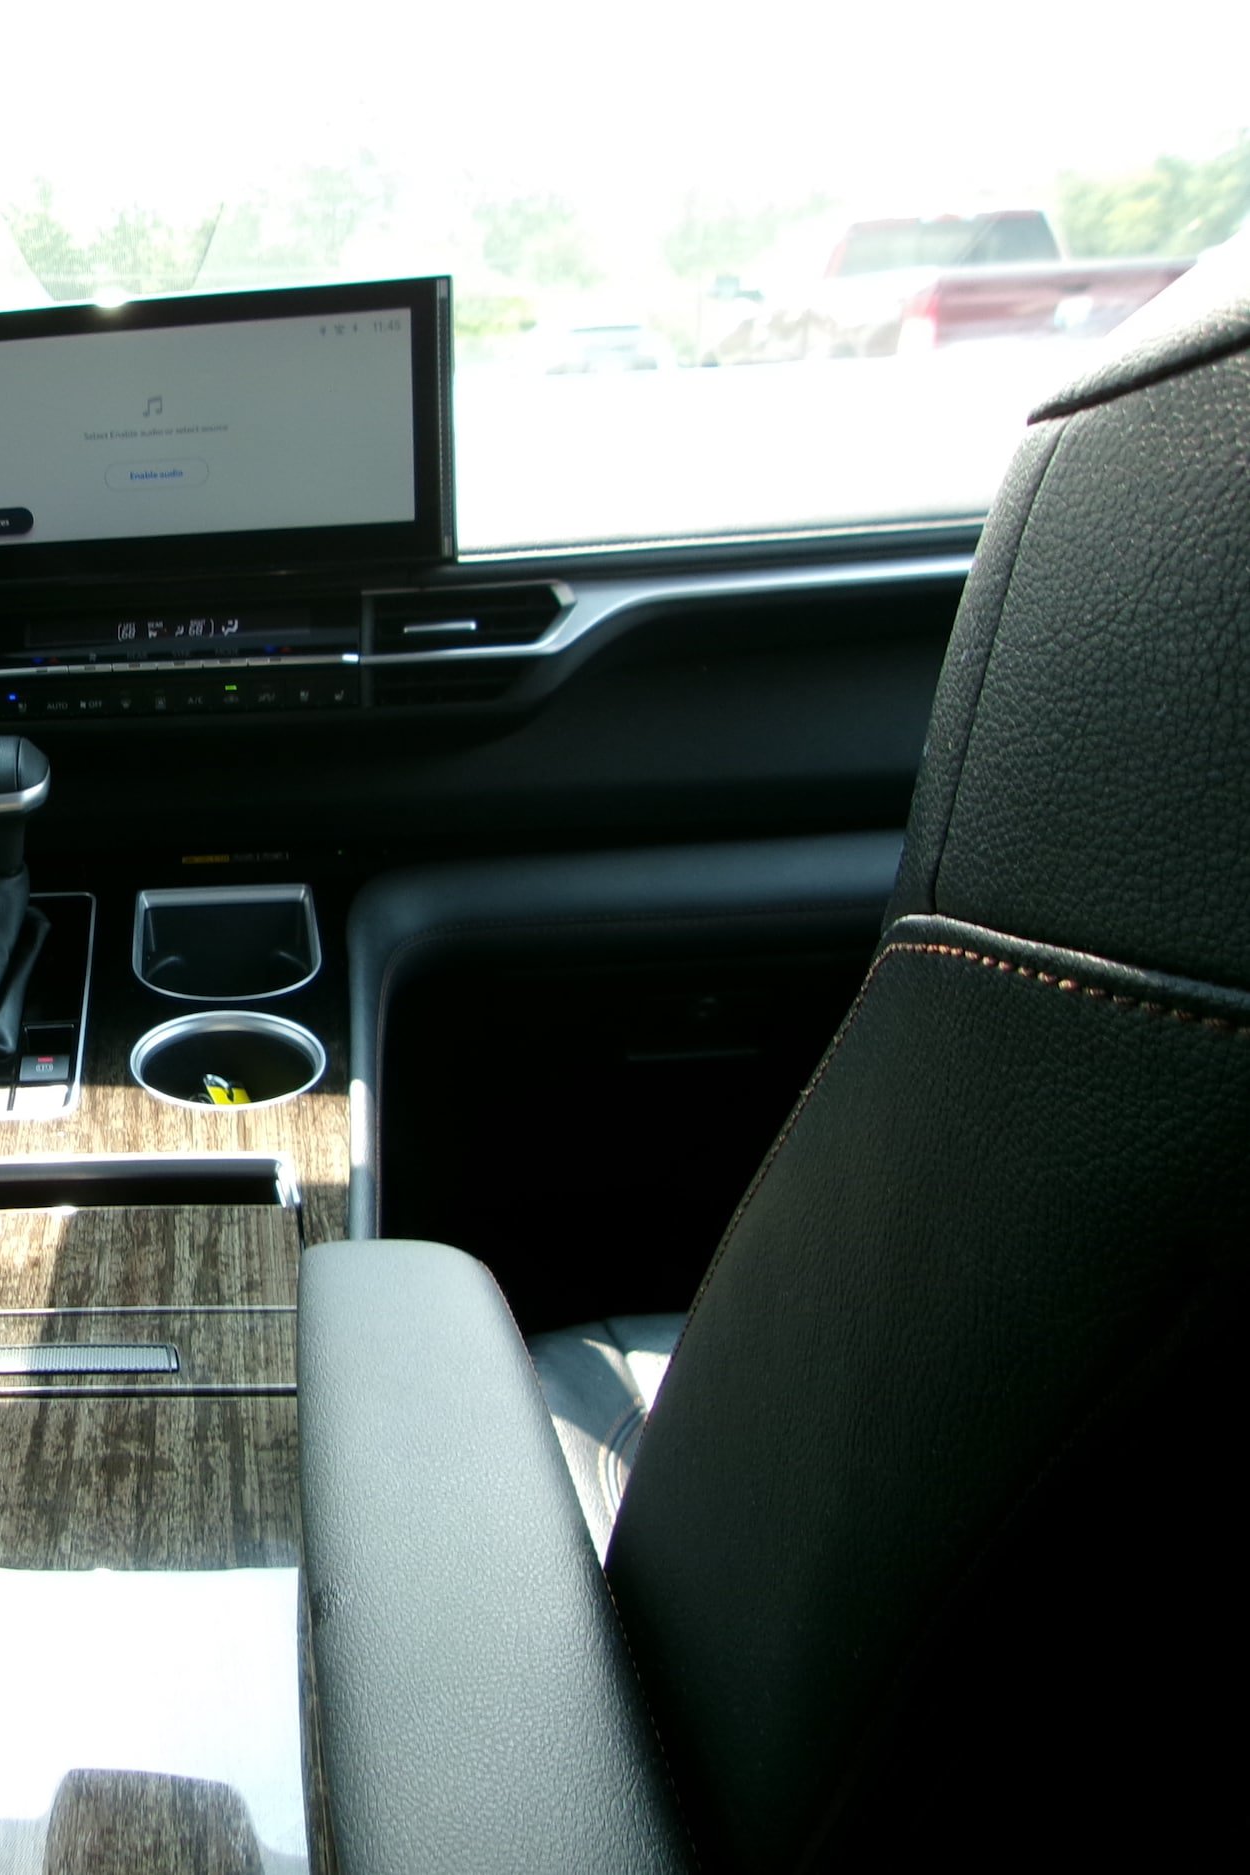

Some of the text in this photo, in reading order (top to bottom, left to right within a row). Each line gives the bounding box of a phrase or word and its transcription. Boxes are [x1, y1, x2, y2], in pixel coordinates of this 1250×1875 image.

[129, 467, 183, 480] Enable audio
[46, 701, 68, 711] AUTO
